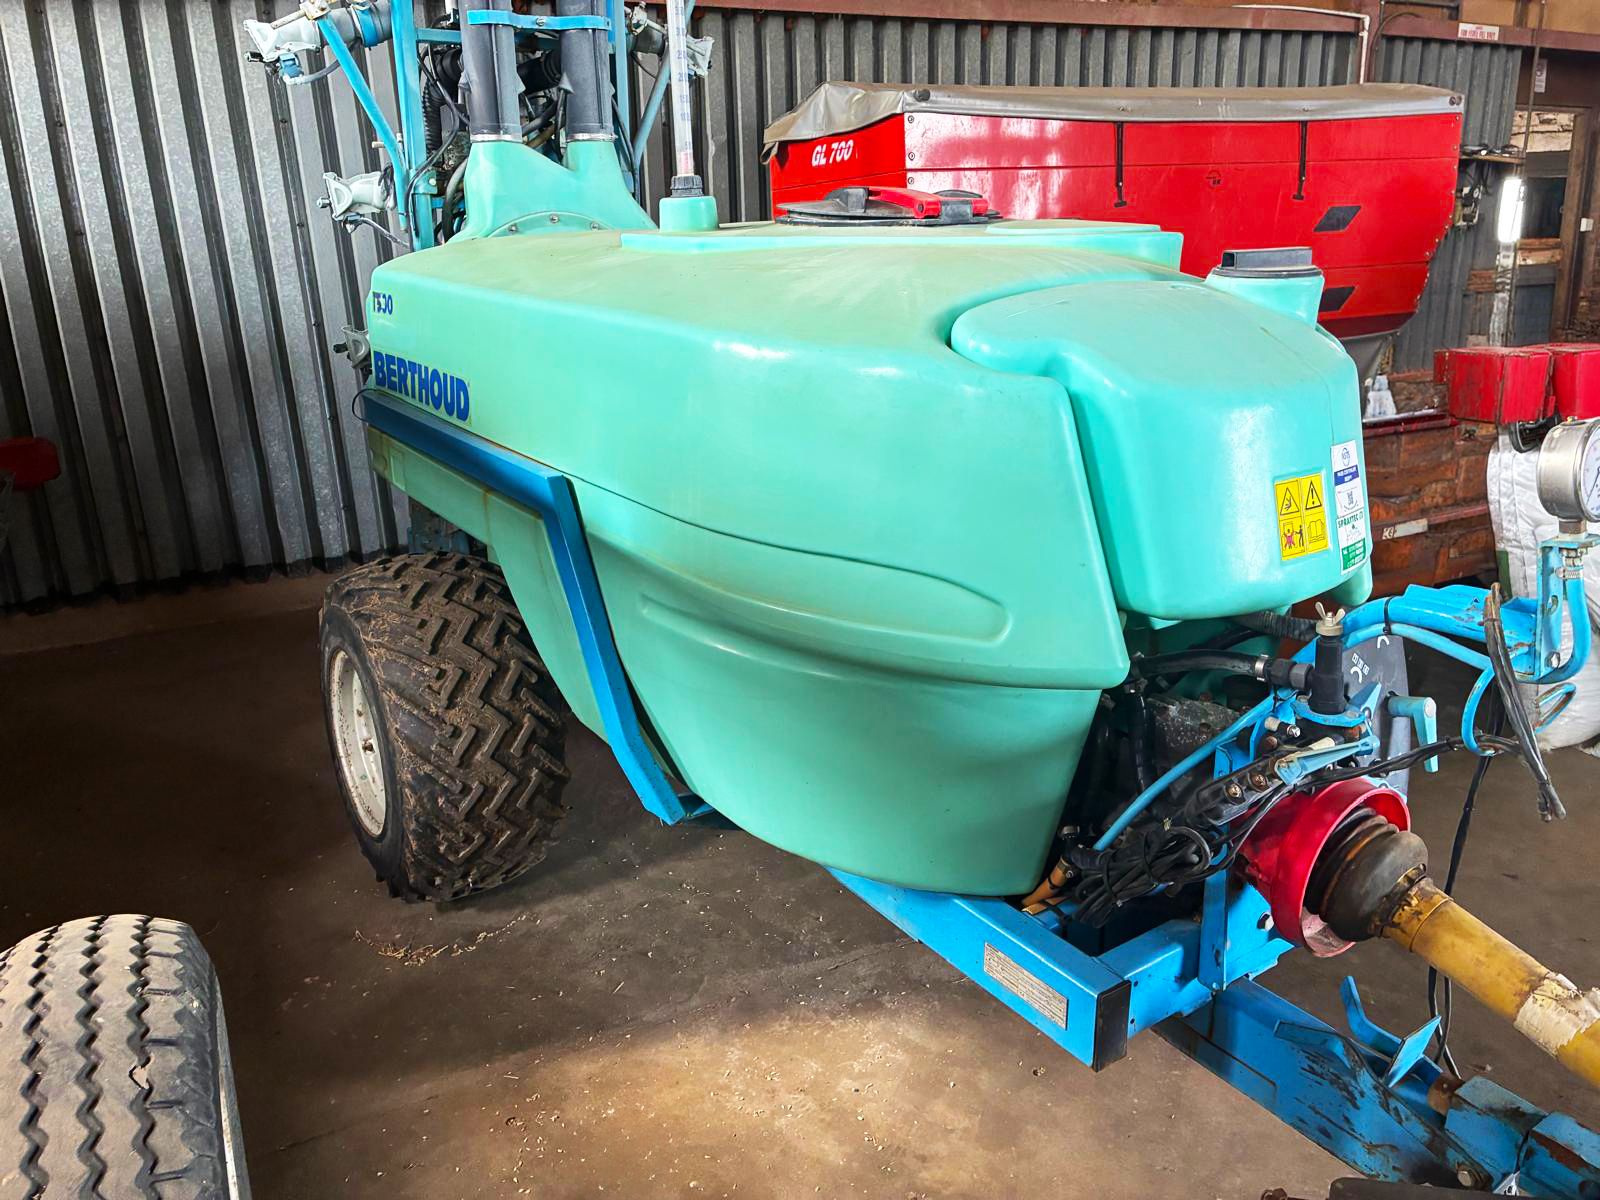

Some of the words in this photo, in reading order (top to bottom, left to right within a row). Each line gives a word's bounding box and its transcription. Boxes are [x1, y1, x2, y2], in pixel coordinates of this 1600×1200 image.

[811, 143, 827, 167] GL
[829, 139, 854, 164] 700
[373, 350, 470, 422] BERTHOUD
